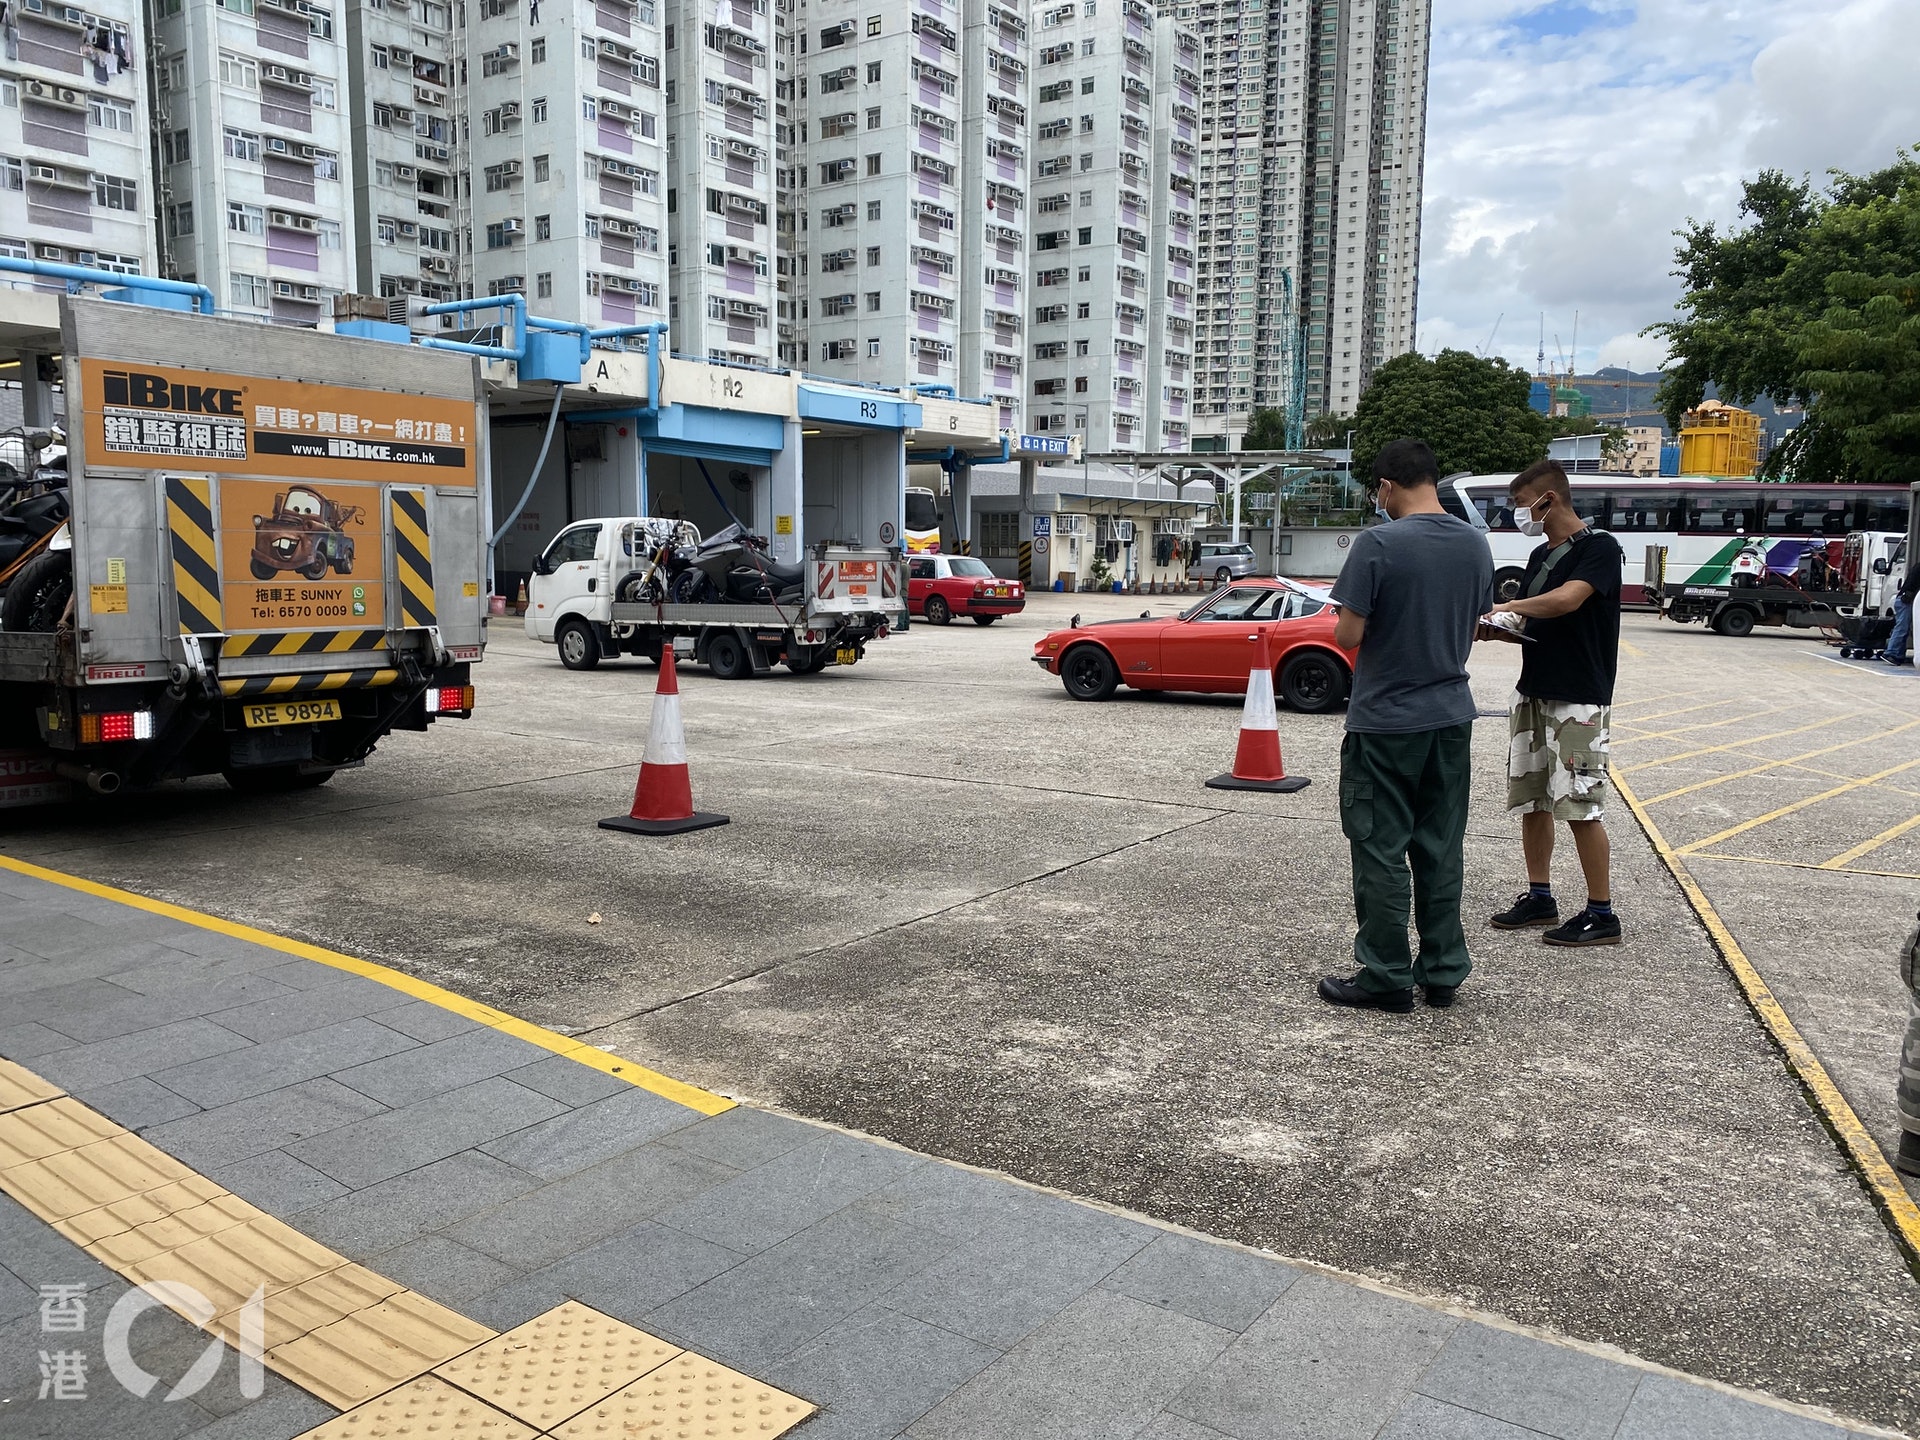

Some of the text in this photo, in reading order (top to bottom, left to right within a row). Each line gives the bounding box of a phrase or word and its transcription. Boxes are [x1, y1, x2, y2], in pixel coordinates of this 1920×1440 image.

[597, 360, 609, 380] A
[723, 375, 743, 398] R2
[861, 401, 877, 419] R3
[950, 415, 959, 430] B
[104, 416, 247, 452] 鐵騎網誌
[1048, 440, 1065, 453] EXIT
[256, 588, 342, 602] 拖車王 SUNNY
[251, 605, 347, 618] Tel: 6570 0009
[88, 665, 146, 680] PIRELLI
[251, 702, 334, 724] RE 9894
